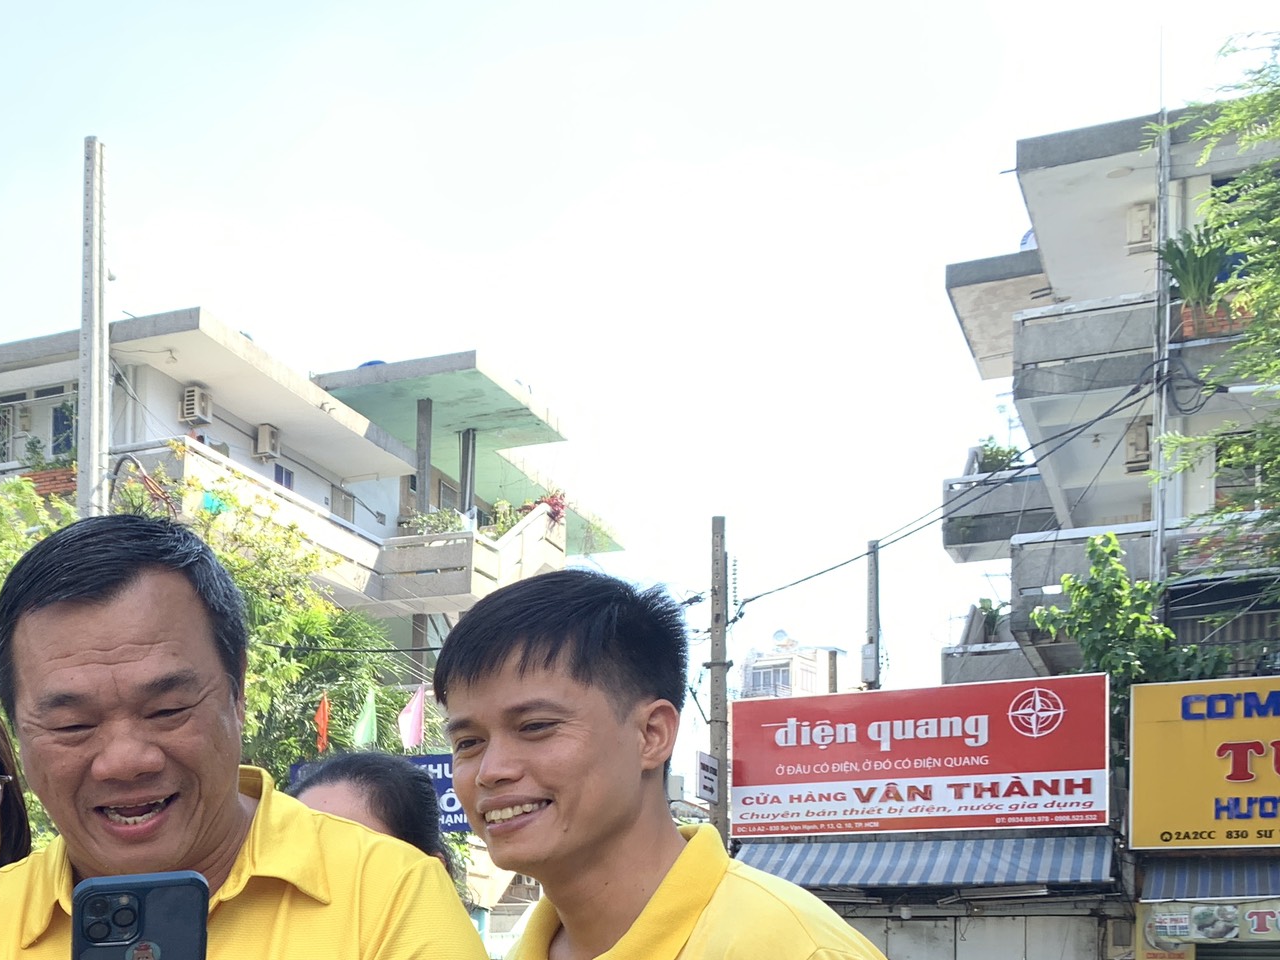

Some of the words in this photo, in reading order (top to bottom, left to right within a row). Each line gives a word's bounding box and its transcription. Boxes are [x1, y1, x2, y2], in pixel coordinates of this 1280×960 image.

[1181, 691, 1280, 720] CƠM
[867, 714, 989, 751] quang
[775, 763, 786, 775] Ở
[786, 762, 811, 775] ĐÂU
[813, 760, 829, 773] CÓ
[831, 760, 860, 774] ĐIỆN,
[862, 759, 872, 771] Ở
[874, 758, 892, 770] ĐÓ
[894, 757, 911, 769] CÓ
[914, 756, 941, 770] ĐIỆN
[944, 755, 989, 768] QUANG
[1216, 739, 1280, 783] T
[741, 792, 782, 806] CỬA
[788, 790, 847, 803] HÀNG
[853, 782, 933, 804] VÂN
[947, 776, 1092, 800] THÀNH
[738, 809, 800, 821] Chuyên
[805, 806, 838, 818] bán
[842, 805, 884, 817] thiết
[887, 805, 904, 816] bị
[957, 801, 1004, 812] nước
[1008, 801, 1042, 812] gia
[1043, 800, 1095, 811] dụng
[1174, 830, 1216, 840] 2A2CC
[1225, 830, 1249, 839] 830
